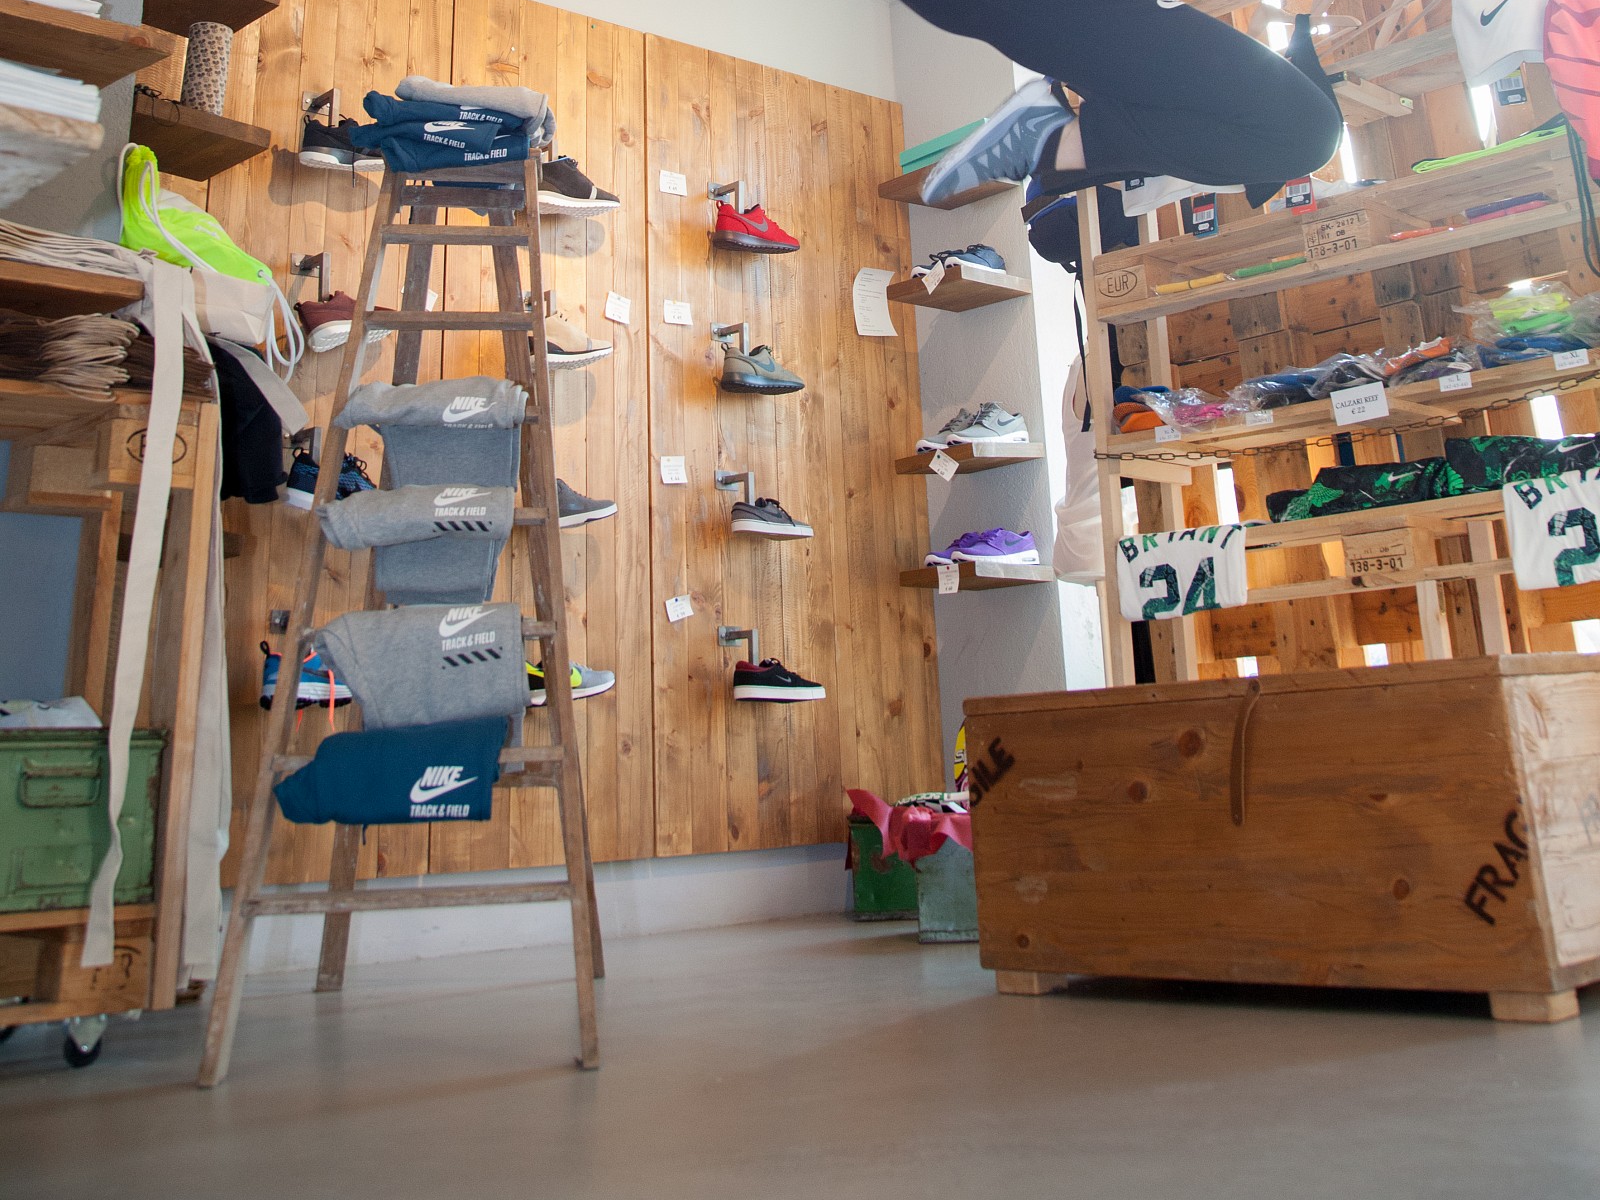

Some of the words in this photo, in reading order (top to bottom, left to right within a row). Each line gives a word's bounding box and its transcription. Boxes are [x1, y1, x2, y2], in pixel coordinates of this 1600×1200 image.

[458, 111, 480, 121] TRACK
[423, 133, 444, 144] TRACK
[448, 139, 466, 149] FIELD
[490, 148, 508, 159] FIELD
[1308, 238, 1358, 259] 138-3-01
[1107, 274, 1129, 294] EUR
[450, 396, 487, 411] NIKE
[441, 487, 479, 498] NIKE
[434, 506, 459, 517] TRACK
[458, 506, 466, 517] &
[465, 506, 487, 517] FIELD
[1350, 557, 1404, 573] 138-3-01
[1139, 556, 1222, 620] 24
[446, 605, 484, 622] NIKE
[441, 636, 467, 652] TRACK
[467, 633, 474, 647] &
[474, 630, 496, 645] FIELD
[419, 765, 464, 789] NIKE
[409, 804, 439, 819] TRACK
[438, 804, 446, 818] &
[446, 804, 470, 818] FIELD
